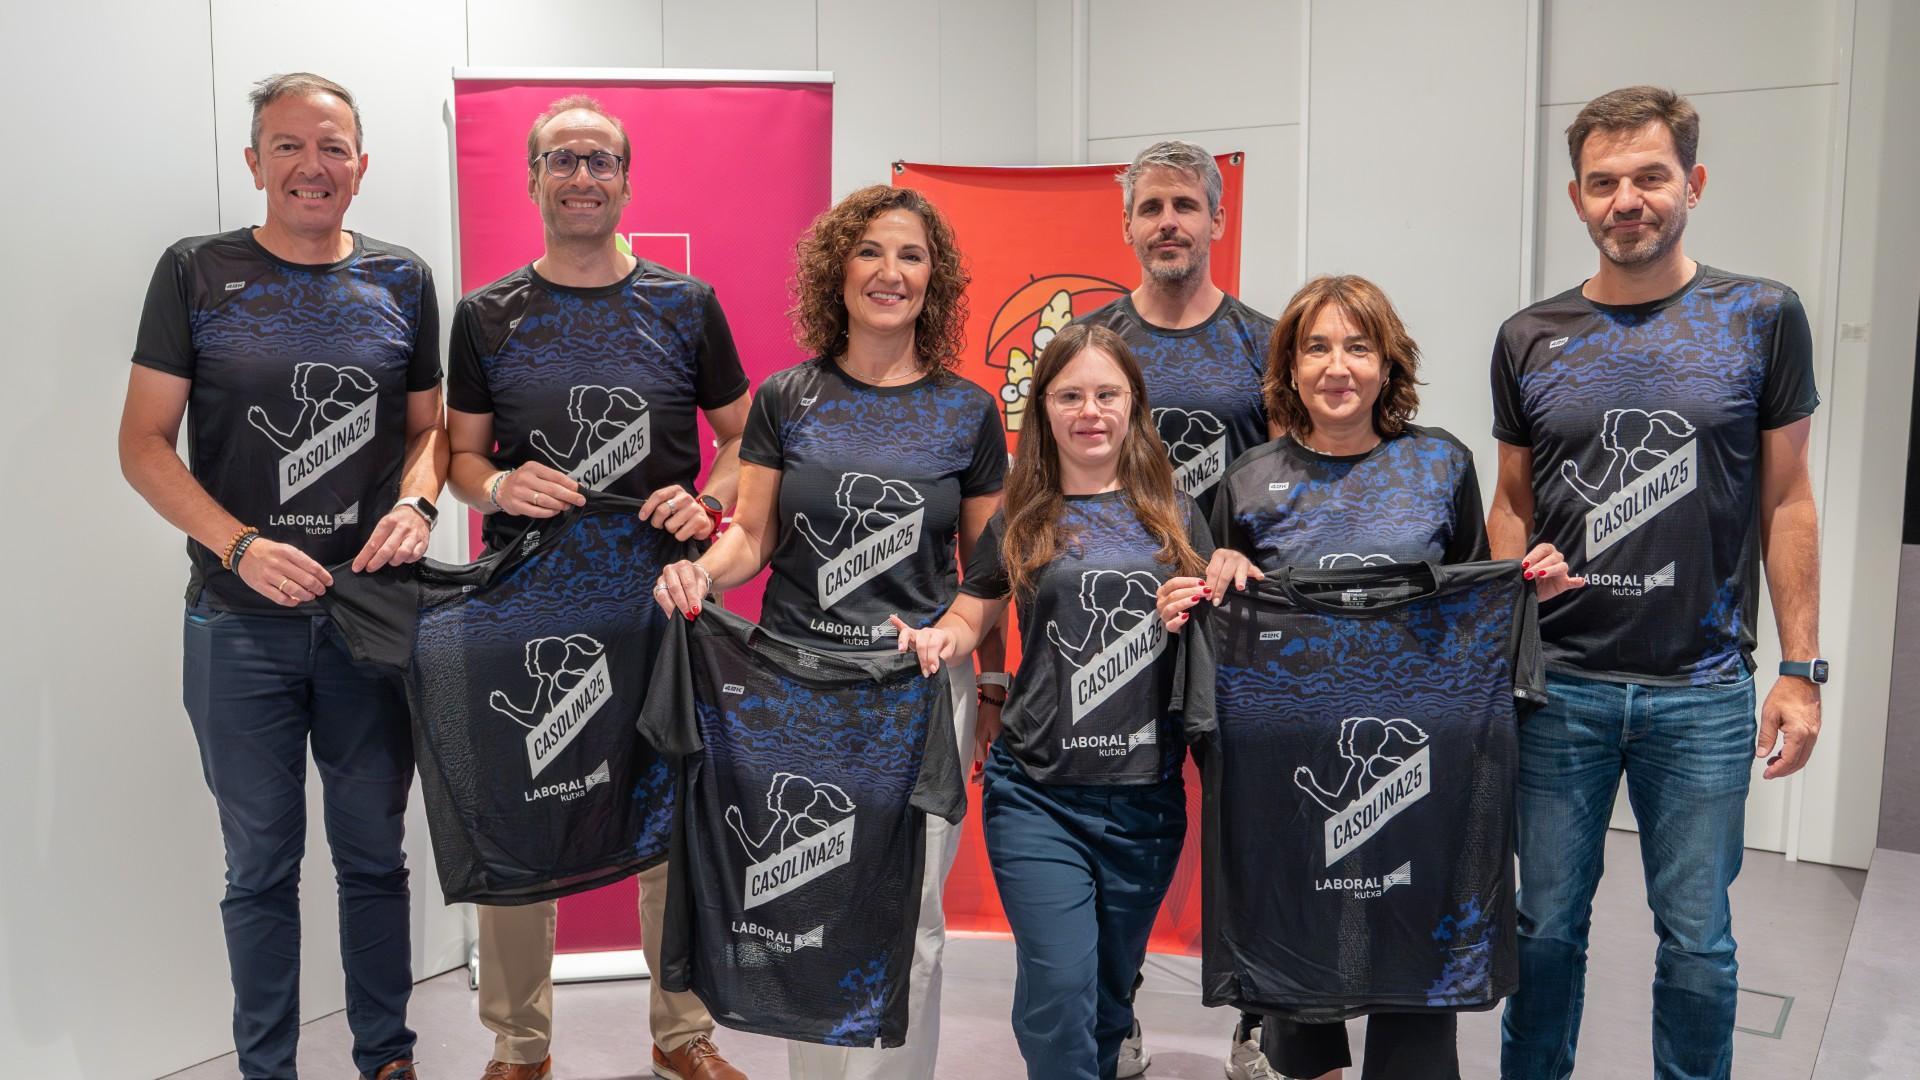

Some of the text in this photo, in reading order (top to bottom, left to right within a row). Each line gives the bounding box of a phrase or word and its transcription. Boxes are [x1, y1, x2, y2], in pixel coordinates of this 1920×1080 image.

[287, 409, 370, 486] CASOLINA25
[577, 427, 644, 490] SOLINA25
[1176, 451, 1219, 493] INA25
[1593, 457, 1689, 543] CASOLINA25
[269, 514, 332, 526] LABORAL
[305, 526, 332, 535] kutxa
[825, 523, 914, 597] CASOLINA25
[1576, 573, 1641, 586] ABORAL
[1612, 587, 1641, 596] kutxa
[810, 618, 869, 637] LABORAL
[843, 635, 870, 646] kutxa
[1078, 619, 1162, 706] CASOLINA25
[534, 670, 605, 761] CASOLINA25
[1062, 734, 1127, 750] LABORAL
[1099, 748, 1127, 757] kutxa
[525, 779, 584, 802] LABORAL
[560, 790, 586, 803] kutxa
[1333, 763, 1422, 850] CASOLINA25
[751, 831, 846, 897] CASOLINA25
[1315, 877, 1381, 891] LABORAL
[1354, 889, 1382, 899] kutxa
[731, 921, 791, 944] LABORAL
[766, 940, 792, 953] kutxa
